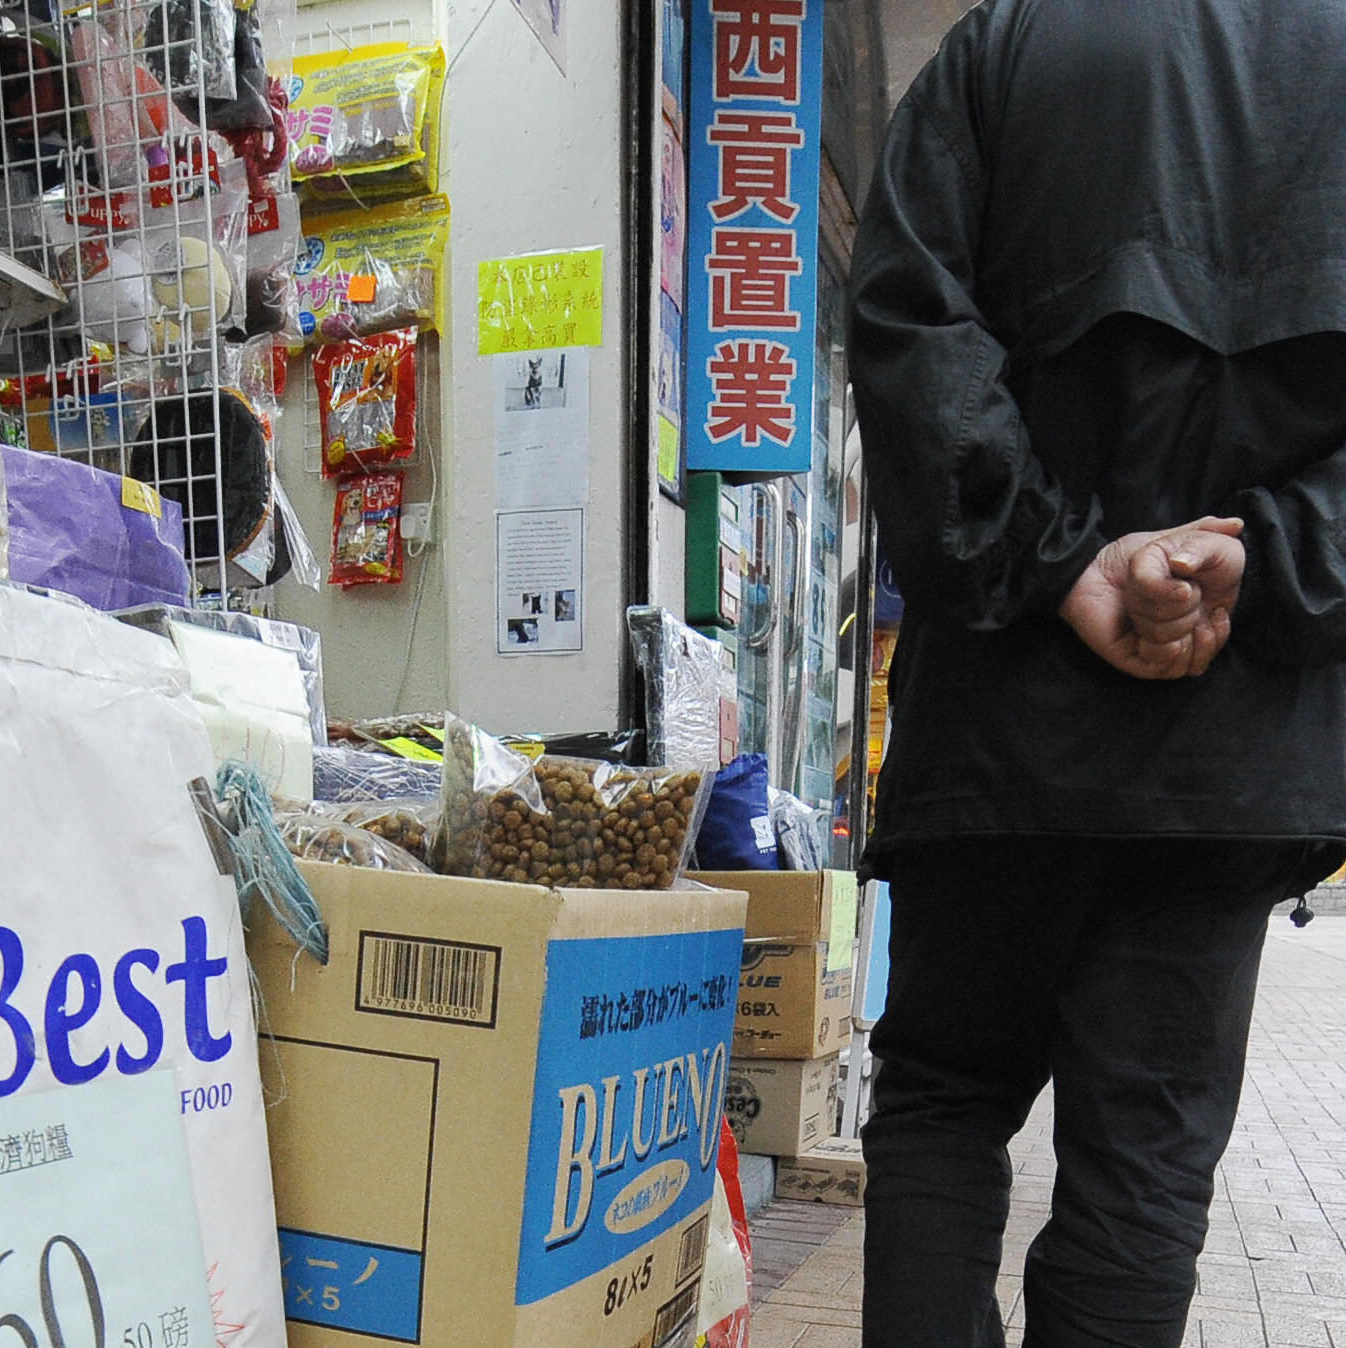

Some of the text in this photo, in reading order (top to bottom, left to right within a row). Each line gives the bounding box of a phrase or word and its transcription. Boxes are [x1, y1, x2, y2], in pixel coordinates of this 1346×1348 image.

[706, 0, 805, 447] 西貢置業
[179, 1080, 233, 1117] FOOD
[543, 1041, 727, 1253] BLUENO
